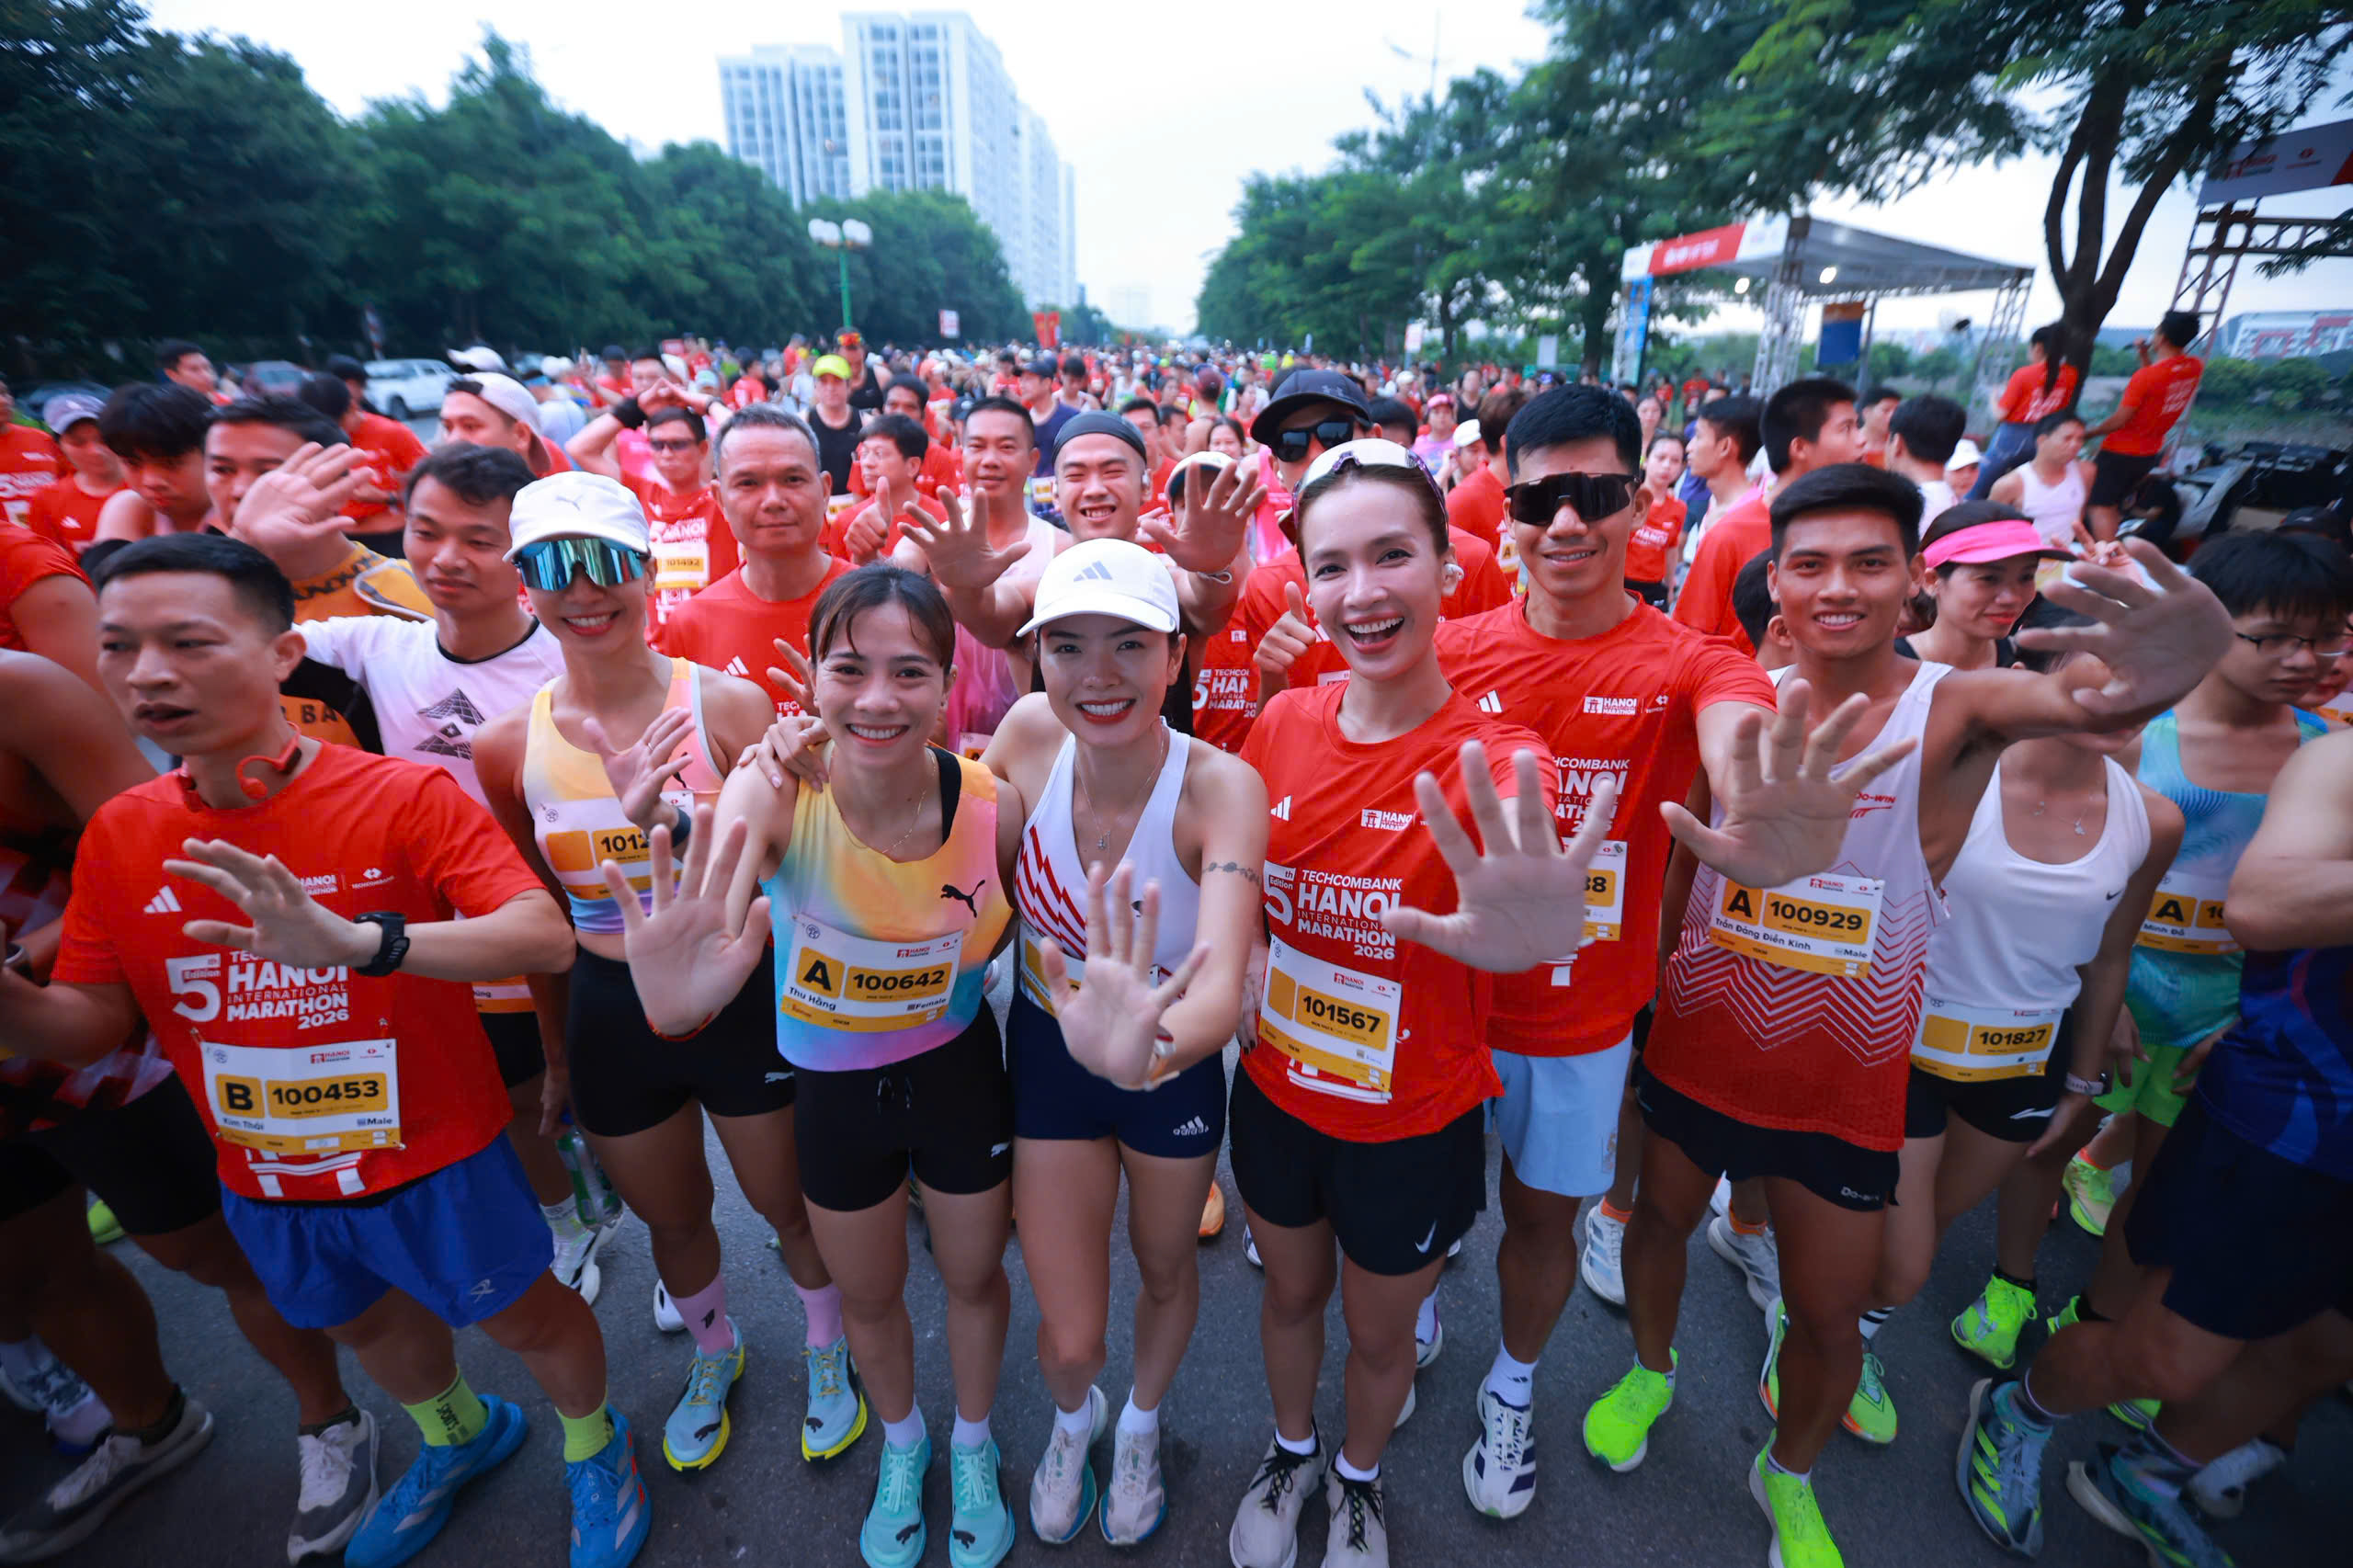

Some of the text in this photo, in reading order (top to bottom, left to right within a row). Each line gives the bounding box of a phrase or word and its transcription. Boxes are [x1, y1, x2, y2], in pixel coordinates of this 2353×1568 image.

[1211, 676, 1248, 694] HAN
[1603, 698, 1637, 708] HANOI
[1269, 876, 1294, 890] Edition
[1302, 869, 1404, 891] TECHCOMBANK
[1263, 858, 1296, 926] 5
[1297, 882, 1401, 922] HANOI
[1727, 889, 1753, 918] A
[1770, 900, 1863, 931] 100929
[2154, 899, 2185, 923] A
[1297, 918, 1396, 947] MARATHON
[1354, 944, 1396, 960] 2026
[1844, 949, 1869, 959] Male
[184, 970, 222, 980] Edition
[227, 961, 349, 994] HANOI
[802, 959, 832, 992] A
[853, 970, 946, 991] 100642
[165, 952, 222, 1023] 5
[227, 983, 347, 1005] INTERNATIONAL
[789, 986, 806, 1000] Thu
[227, 992, 349, 1023] MARATHON
[915, 998, 947, 1010] Female
[1302, 994, 1381, 1033] 101567
[297, 1007, 350, 1030] 2026
[1979, 1028, 2047, 1046] 101827
[225, 1082, 254, 1111] B
[272, 1079, 380, 1106] 100453
[367, 1118, 392, 1126] Male
